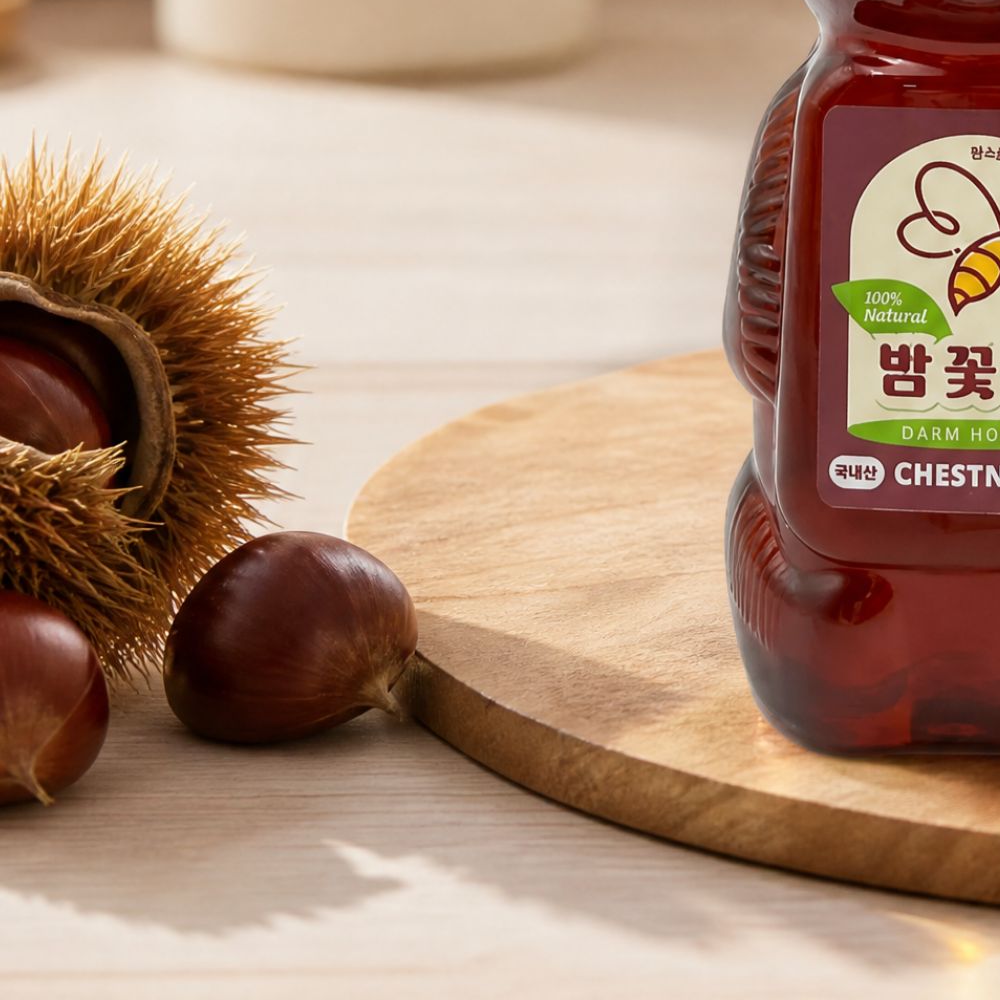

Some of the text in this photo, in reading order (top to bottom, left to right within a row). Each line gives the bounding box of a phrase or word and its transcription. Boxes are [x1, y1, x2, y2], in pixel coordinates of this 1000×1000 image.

[864, 290, 903, 307] 100%
[864, 308, 928, 325] Natural
[902, 425, 960, 442] DARM
[834, 465, 878, 482] 국내산
